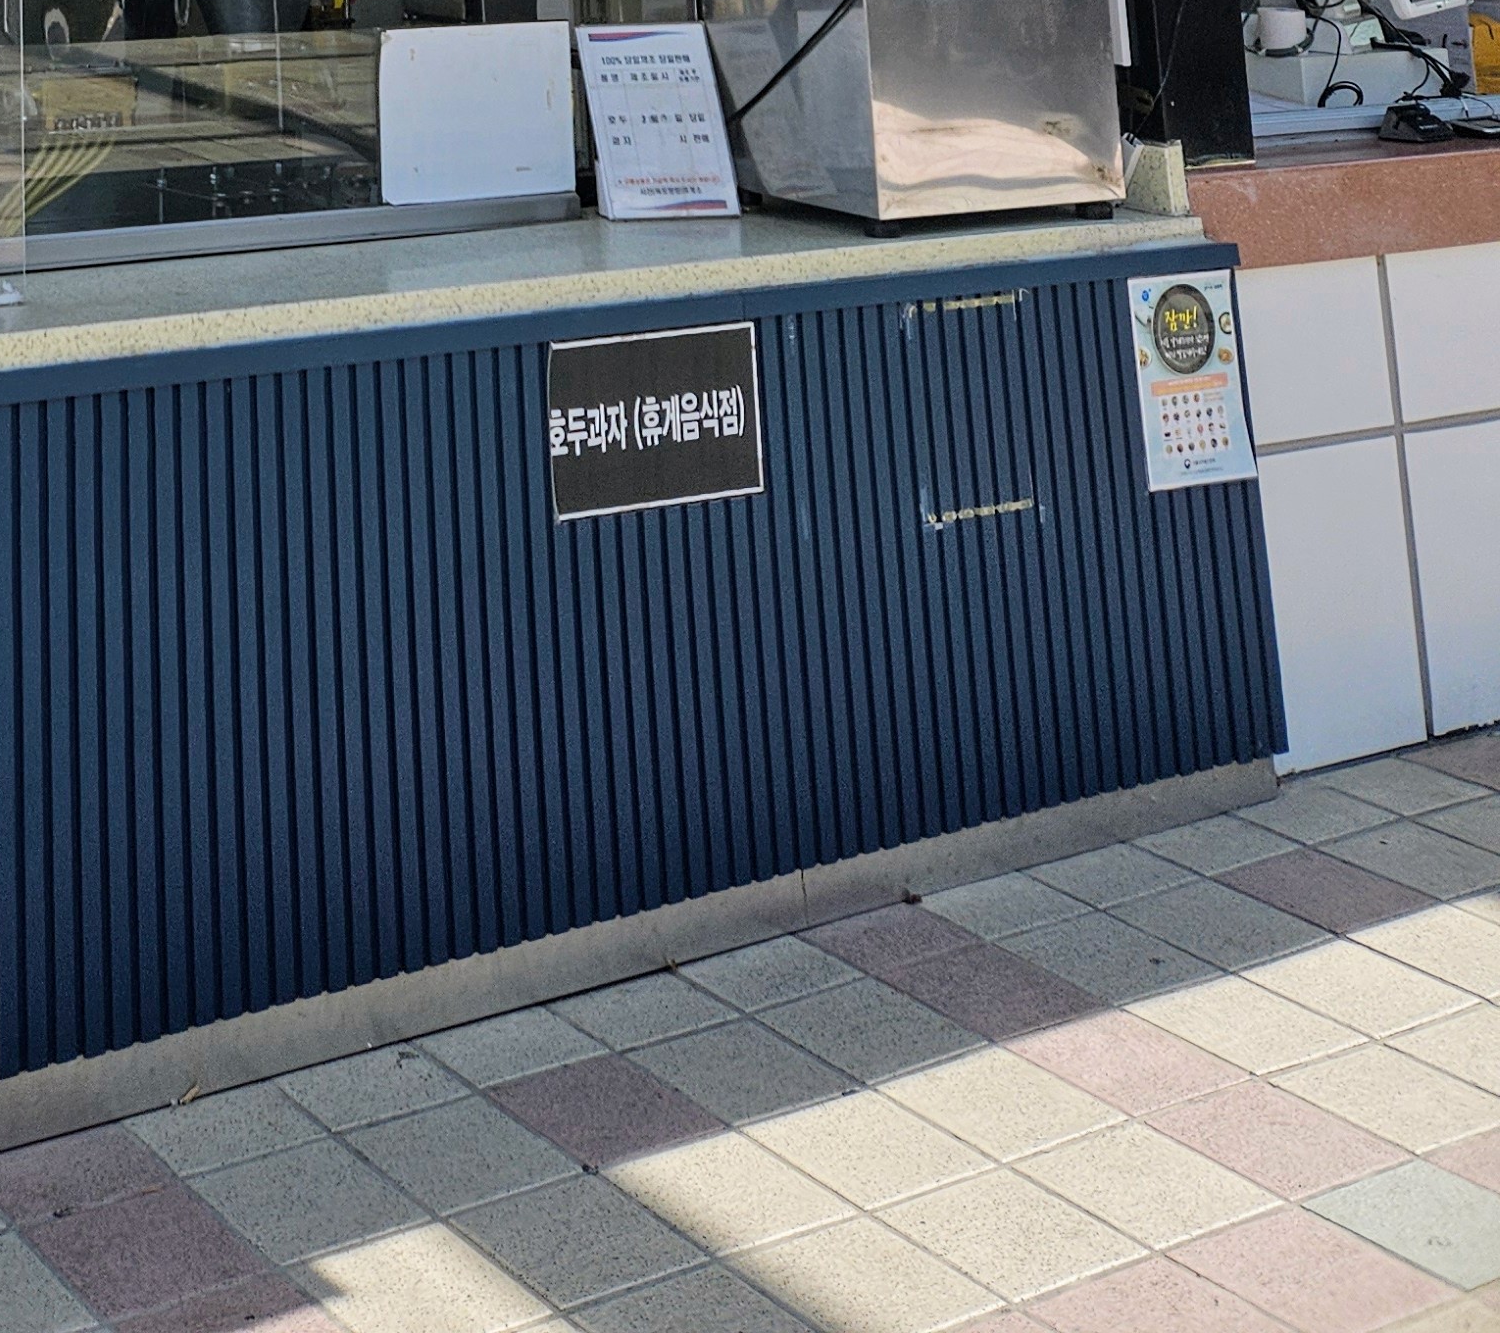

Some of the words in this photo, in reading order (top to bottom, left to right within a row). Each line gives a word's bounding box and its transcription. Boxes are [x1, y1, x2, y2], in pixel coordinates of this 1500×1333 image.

[1163, 305, 1198, 332] 잠깐!
[550, 400, 629, 457] 호두과자
[633, 383, 746, 451] (휴게음식점)
